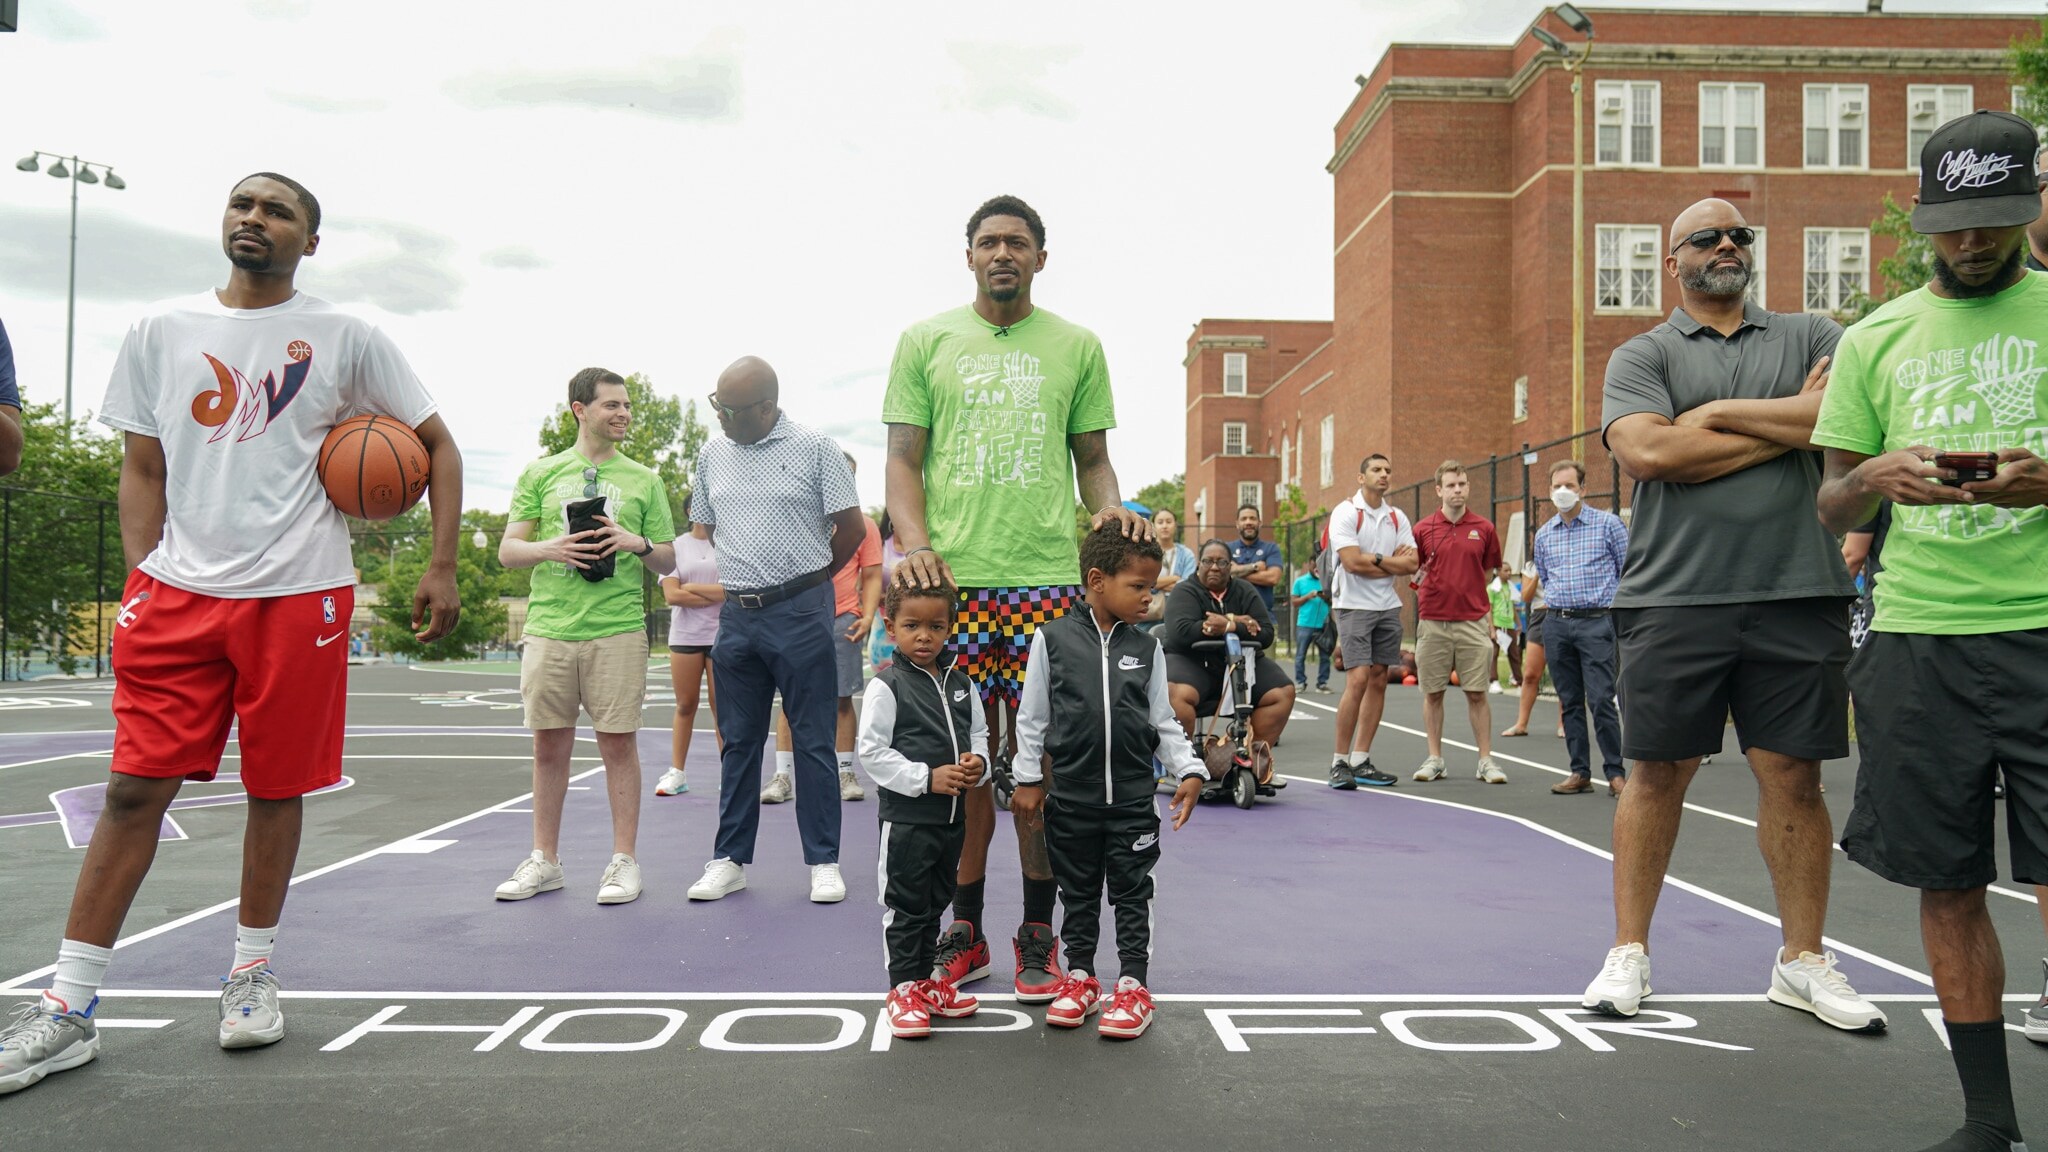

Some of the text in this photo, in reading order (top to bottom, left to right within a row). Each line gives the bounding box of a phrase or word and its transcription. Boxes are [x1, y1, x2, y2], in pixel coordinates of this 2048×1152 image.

[955, 349, 1041, 379] ONE SHOT
[1895, 332, 2039, 390] ONE SHOT
[964, 388, 1006, 406] CAN
[956, 409, 1047, 435] SAVE A
[1912, 400, 1977, 431] CAN
[955, 432, 1044, 489] LIFE
[320, 1005, 1755, 1053] HOOP FOR
